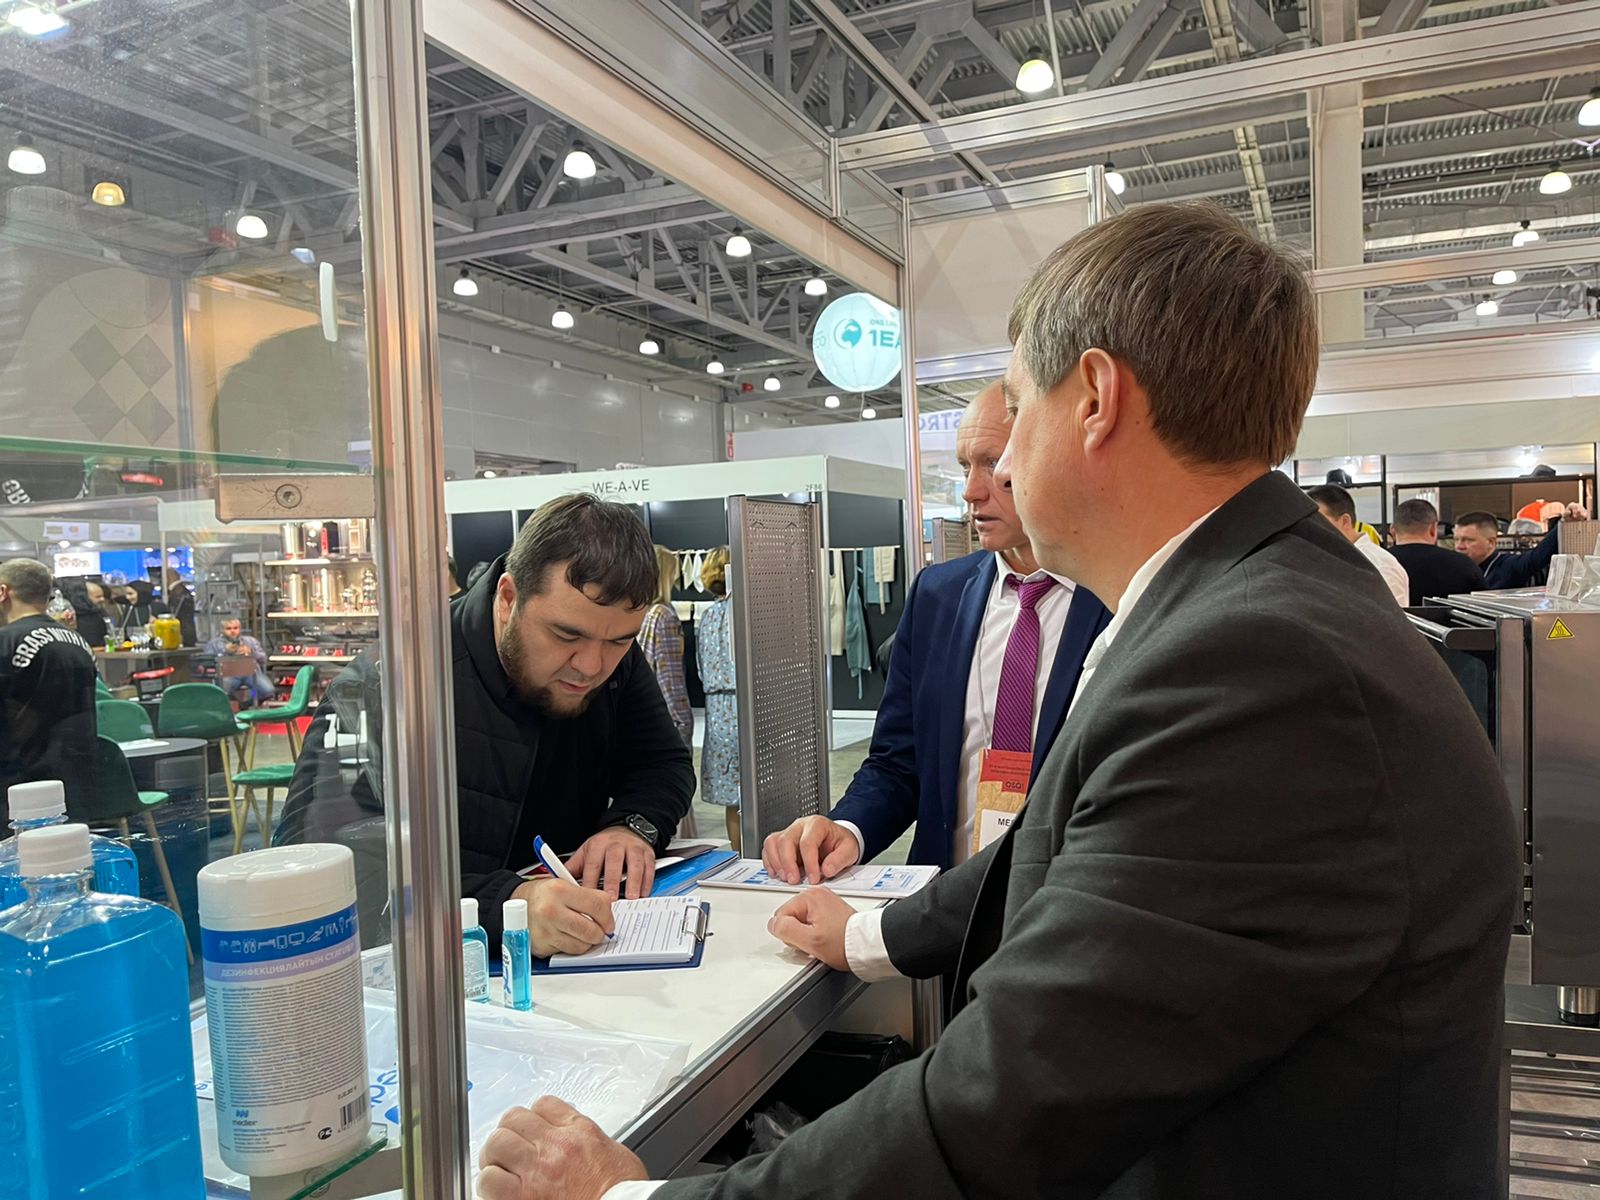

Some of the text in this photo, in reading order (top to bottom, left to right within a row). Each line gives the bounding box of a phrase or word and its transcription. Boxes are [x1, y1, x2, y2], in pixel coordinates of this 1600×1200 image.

[592, 479, 650, 493] WE-A-VE
[12, 627, 55, 668] GRASS
[47, 627, 81, 647] WITH
